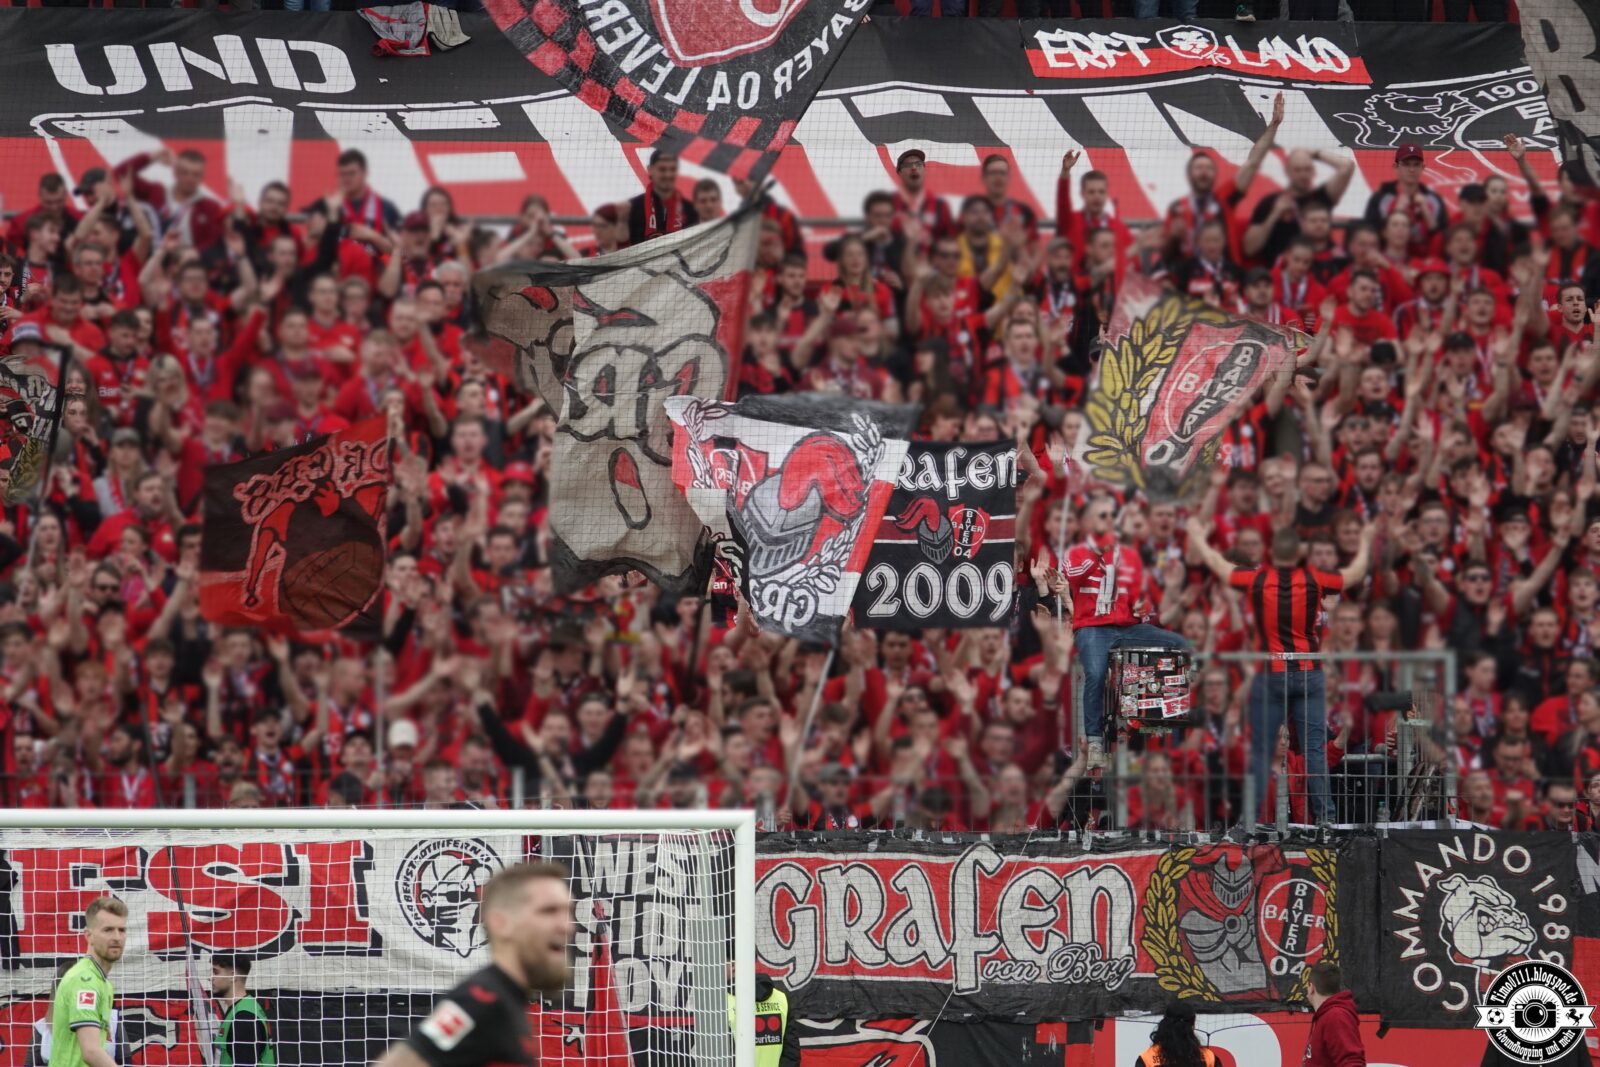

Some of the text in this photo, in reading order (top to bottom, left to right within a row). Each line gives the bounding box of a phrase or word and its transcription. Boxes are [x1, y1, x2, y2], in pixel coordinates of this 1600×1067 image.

[44, 34, 357, 96] UND
[1225, 34, 1351, 74] LAND
[1475, 79, 1540, 102] 190
[1177, 371, 1243, 403] BAYE
[1181, 345, 1255, 435] BAYER
[951, 521, 983, 533] BAYER
[962, 510, 973, 544] BAYER
[953, 546, 972, 559] 04
[866, 561, 1015, 622] 2009
[1264, 903, 1326, 929] BAYER
[1285, 882, 1309, 952] BAYER
[1393, 833, 1535, 1011] COMMANDO
[1047, 943, 1136, 991] Berg
[1269, 955, 1307, 977] 04
[755, 1034, 780, 1044] curitas
